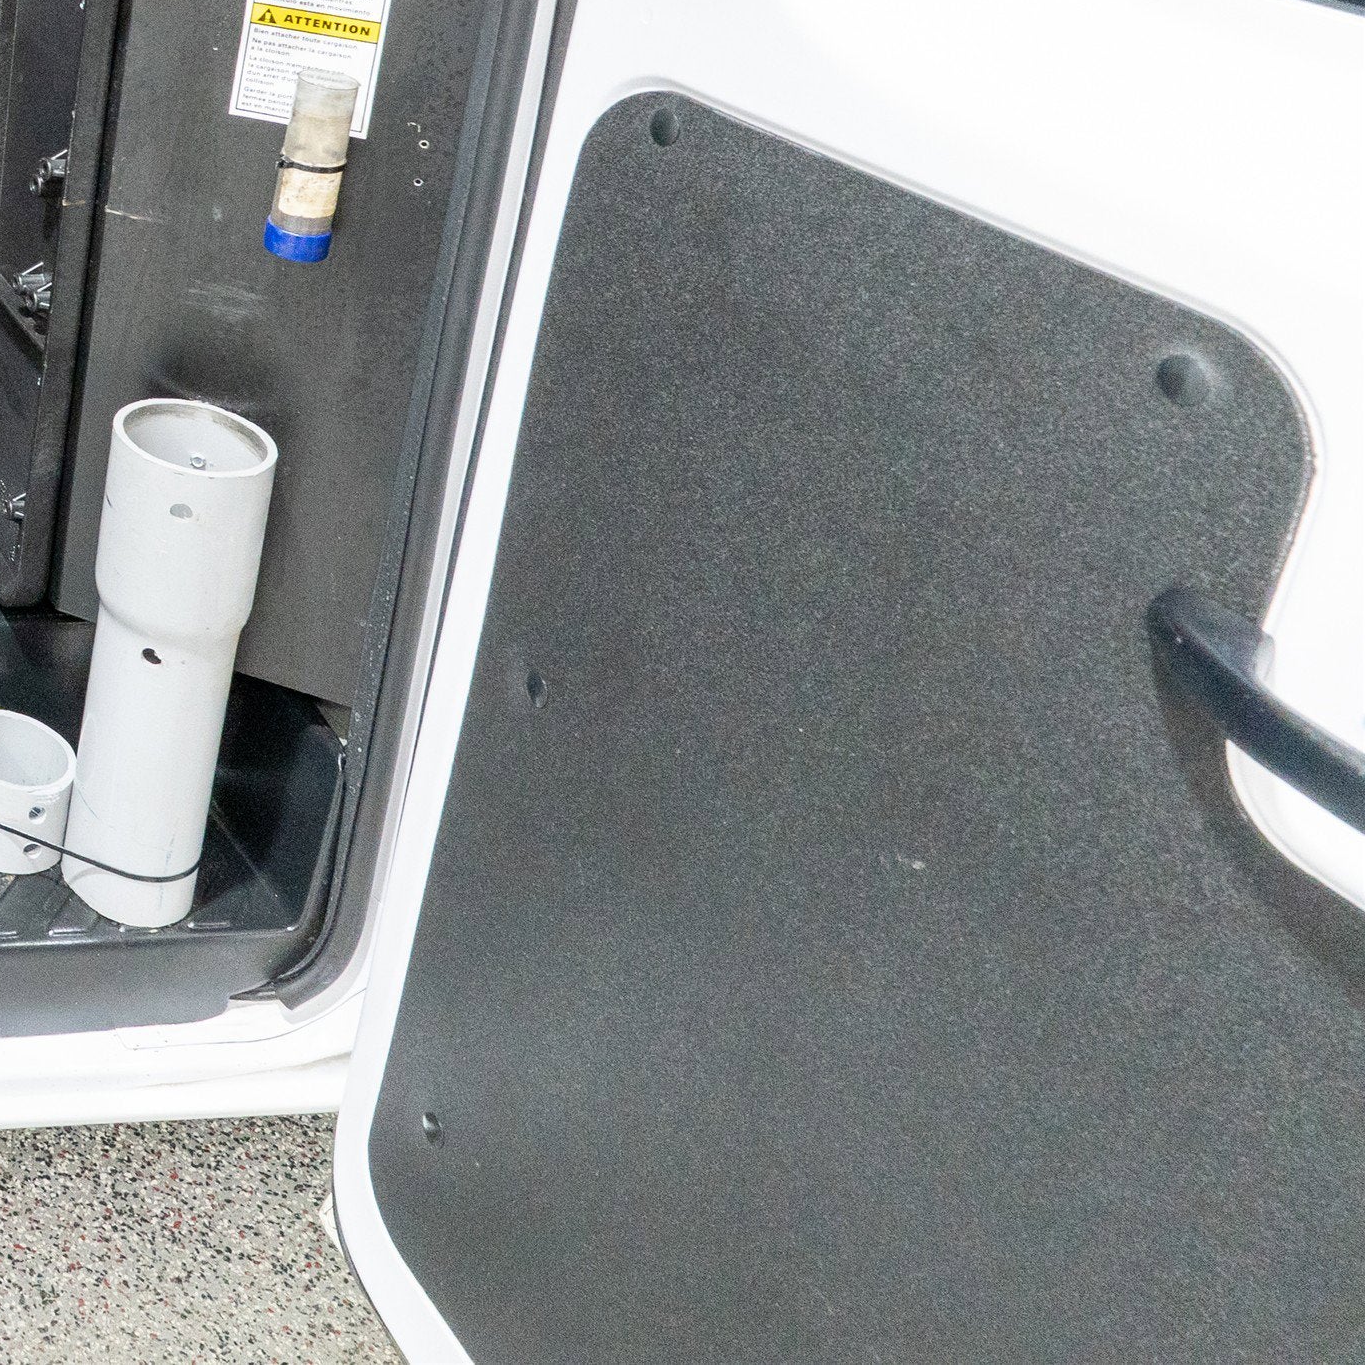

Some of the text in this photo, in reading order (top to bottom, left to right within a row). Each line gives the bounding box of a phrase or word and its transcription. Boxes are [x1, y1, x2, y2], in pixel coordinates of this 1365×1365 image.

[327, 5, 370, 16] movimiento
[284, 15, 370, 36] ATTENTION
[271, 31, 300, 40] attacher
[278, 42, 307, 51] attacher
[244, 86, 267, 94] Garder
